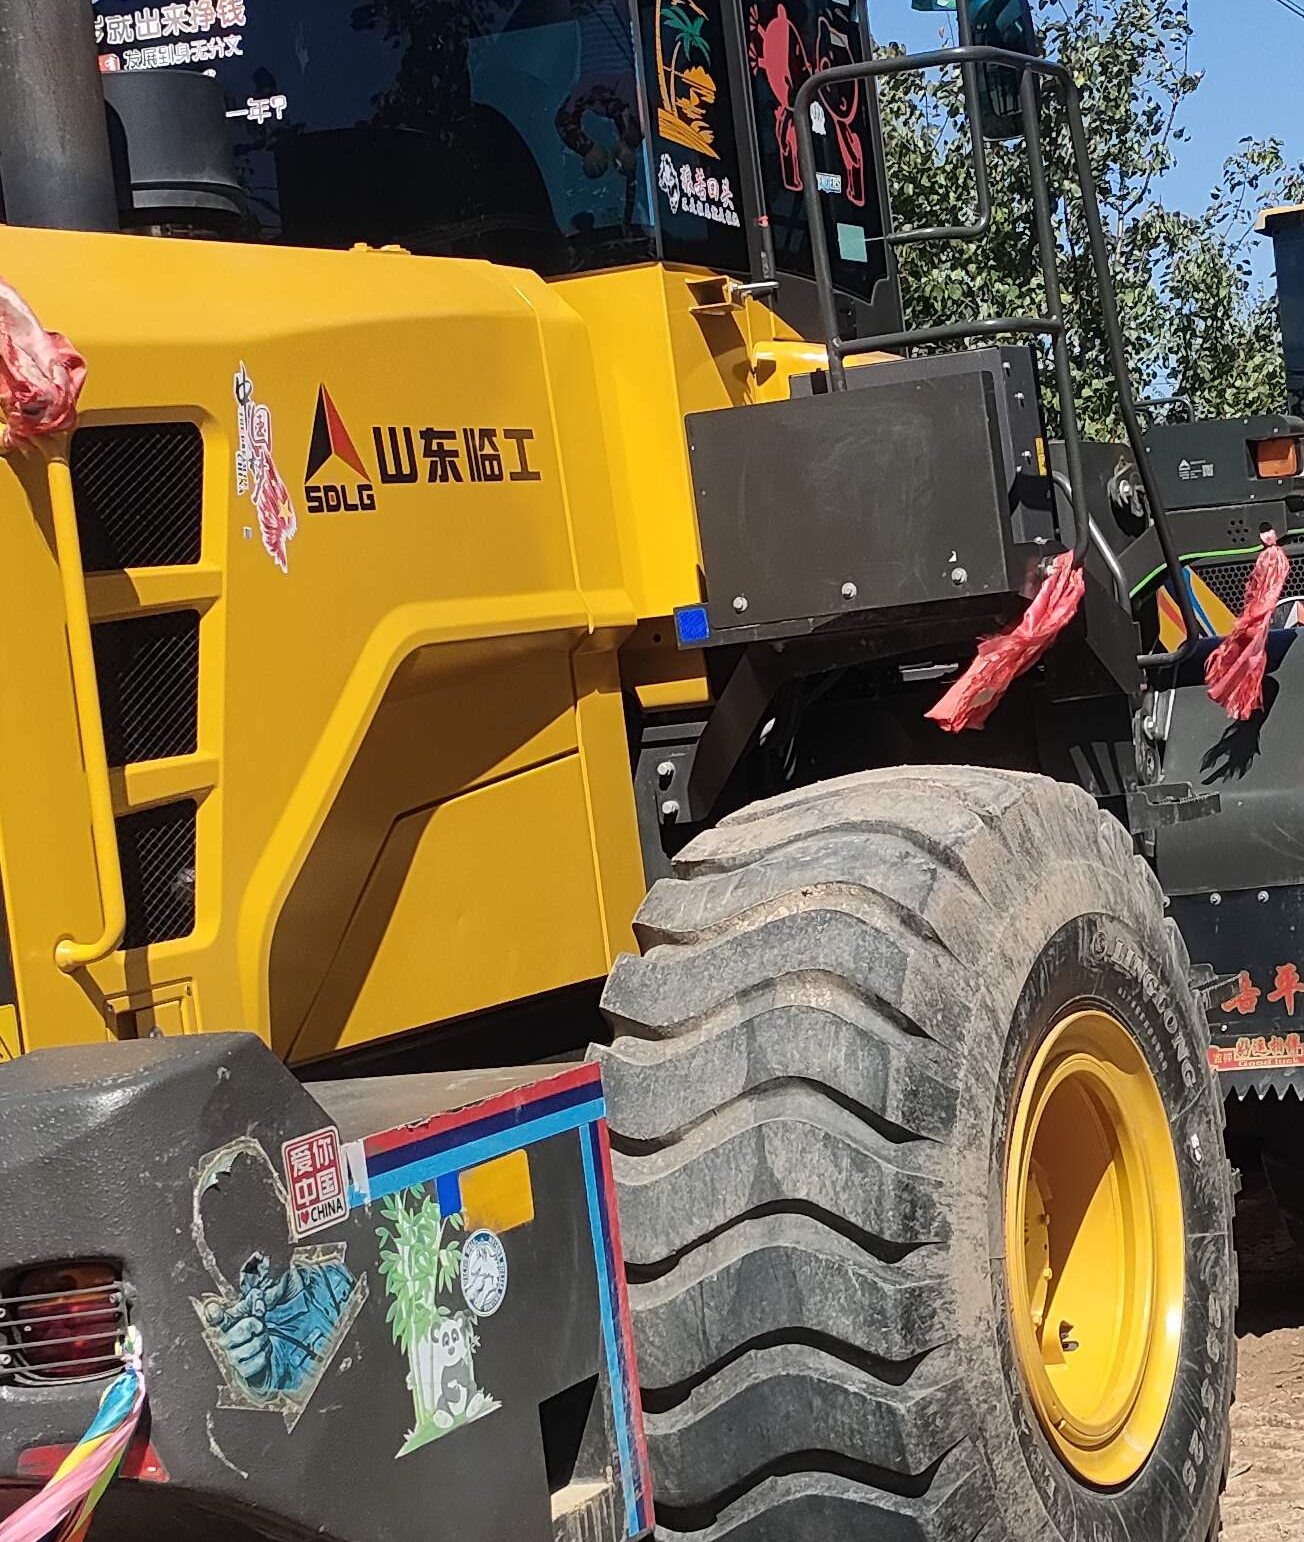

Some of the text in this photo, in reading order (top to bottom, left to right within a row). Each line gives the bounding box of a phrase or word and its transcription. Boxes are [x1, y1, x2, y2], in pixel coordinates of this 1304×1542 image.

[372, 426, 541, 484] 山东临工
[304, 484, 377, 513] SDLG
[1111, 938, 1197, 1088] LINGLONG
[290, 1138, 335, 1178] 爱你
[294, 1167, 340, 1207] 中国
[310, 1198, 344, 1223] CHINA
